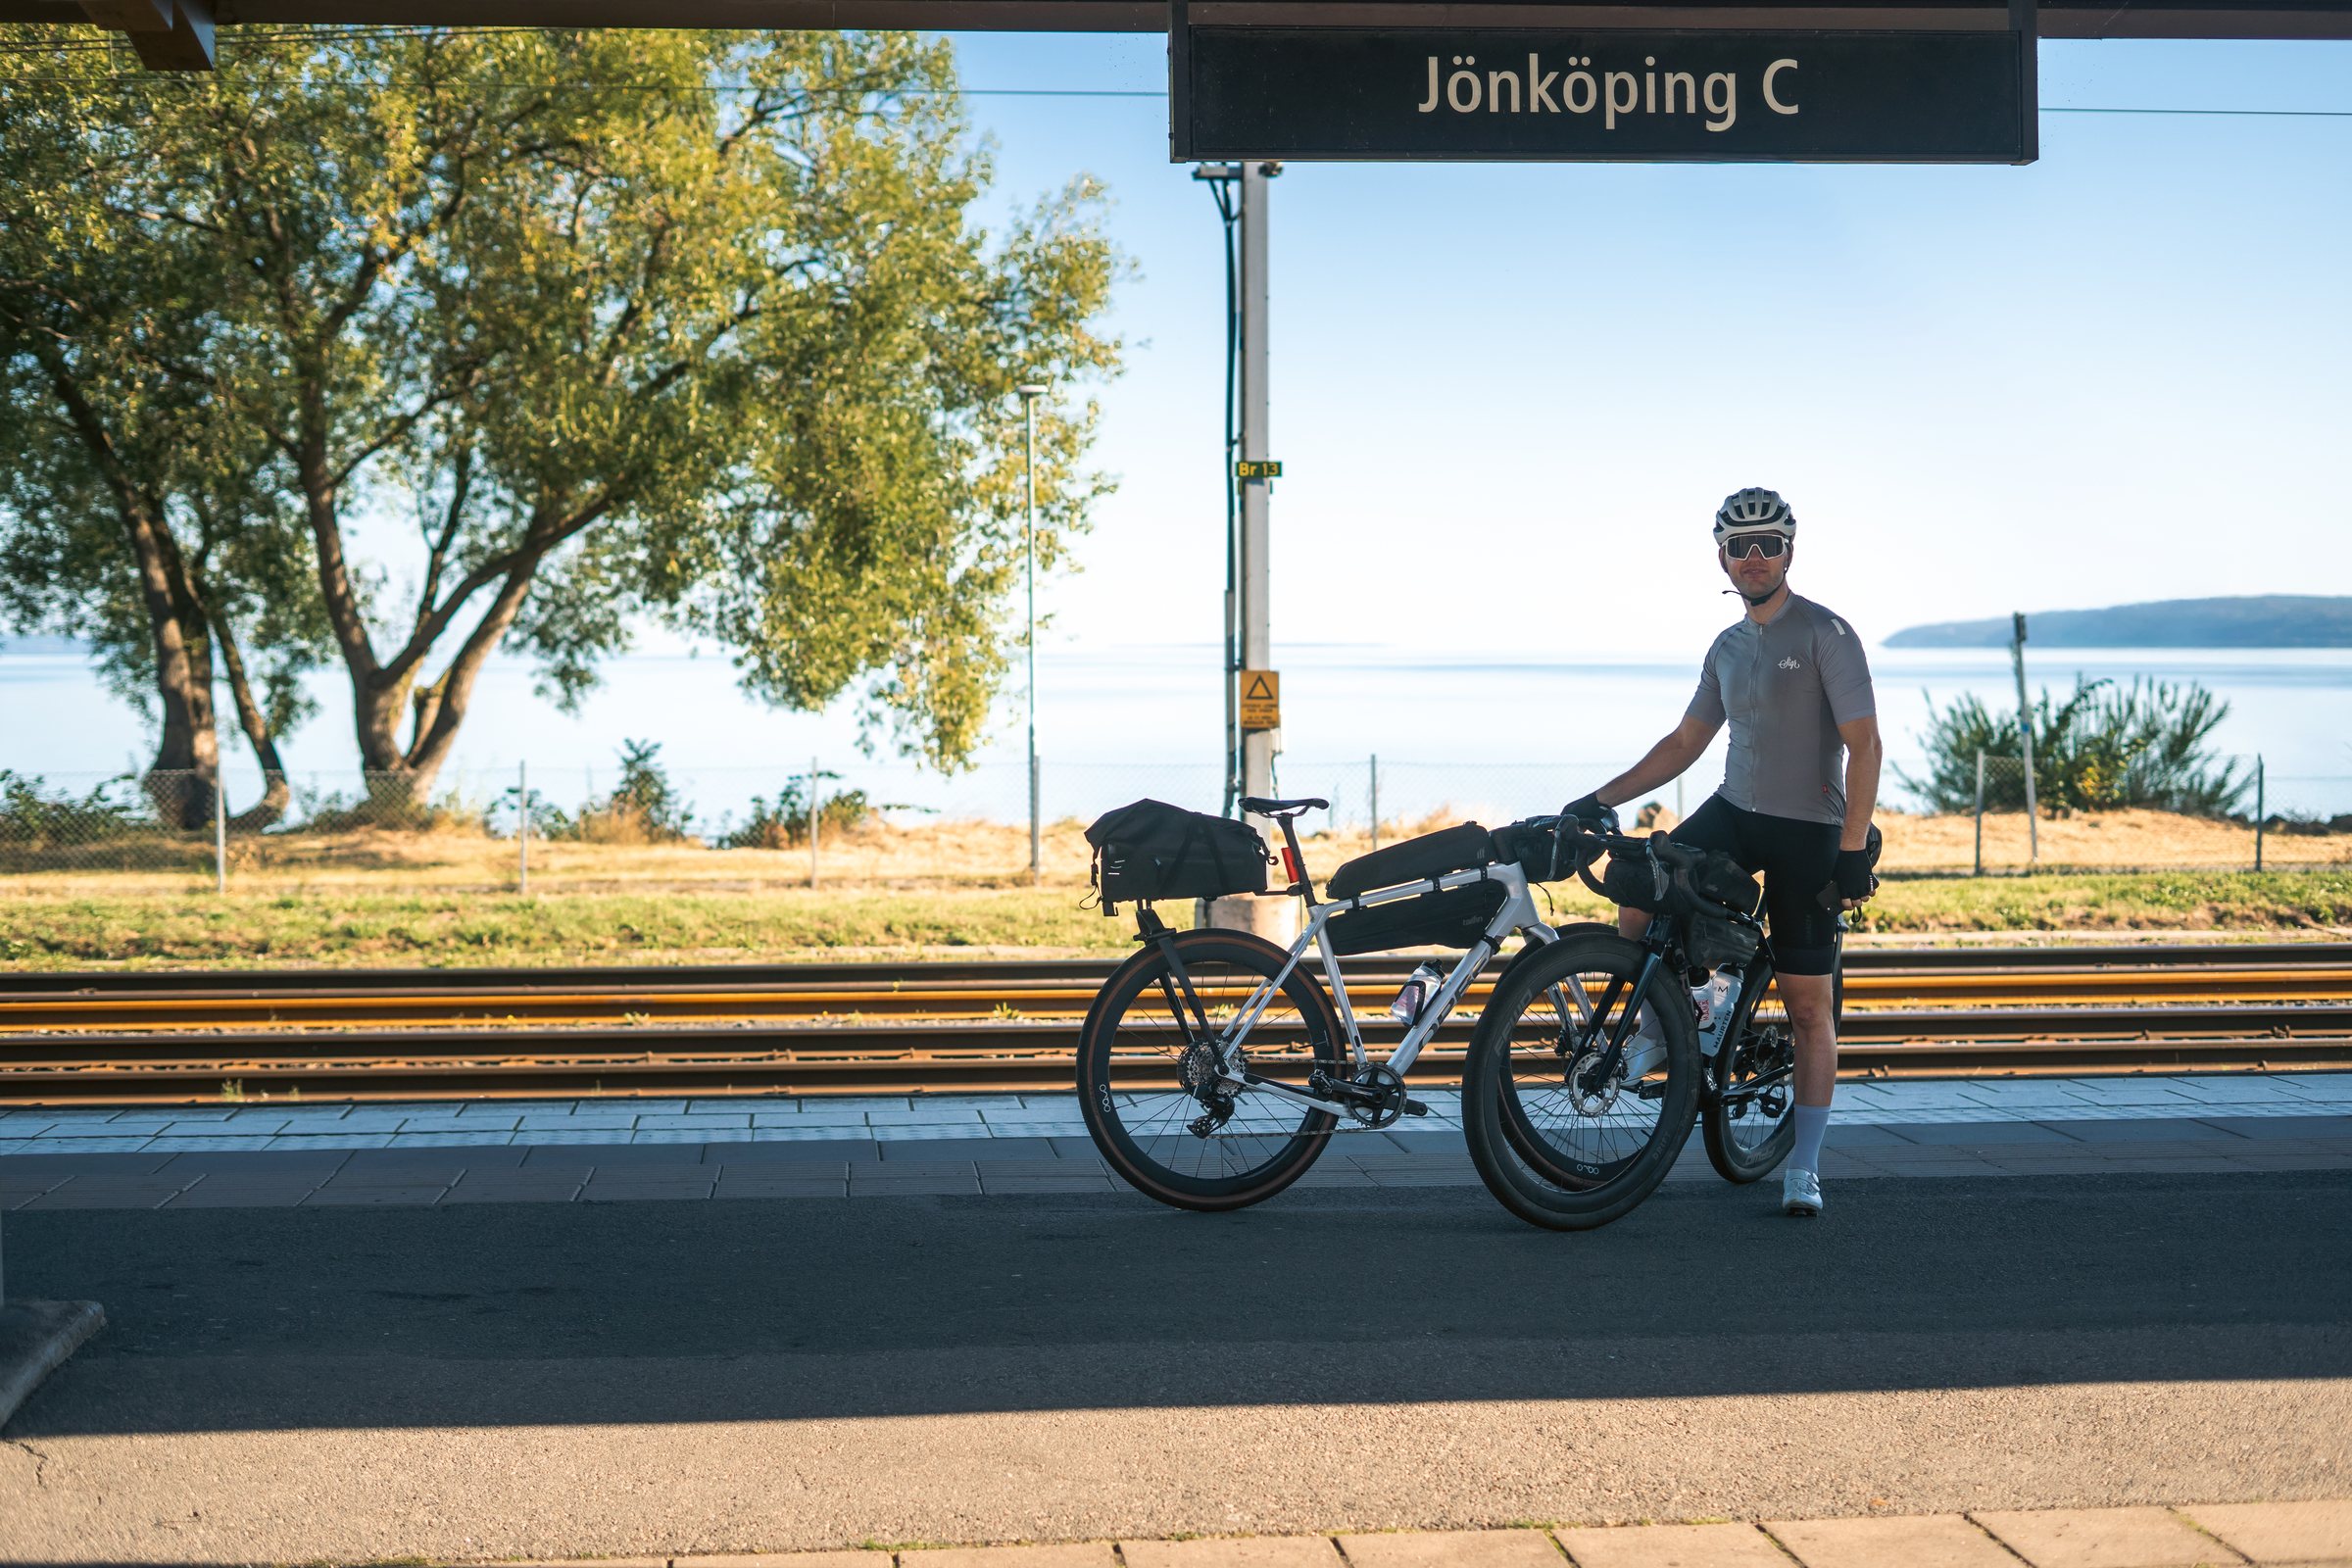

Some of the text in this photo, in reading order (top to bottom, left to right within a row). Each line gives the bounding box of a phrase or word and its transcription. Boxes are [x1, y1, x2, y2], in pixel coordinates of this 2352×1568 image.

[1418, 53, 1800, 132] Jönköping C
[1239, 462, 1279, 477] Br 13
[1713, 1009, 1732, 1049] MAURTEN
